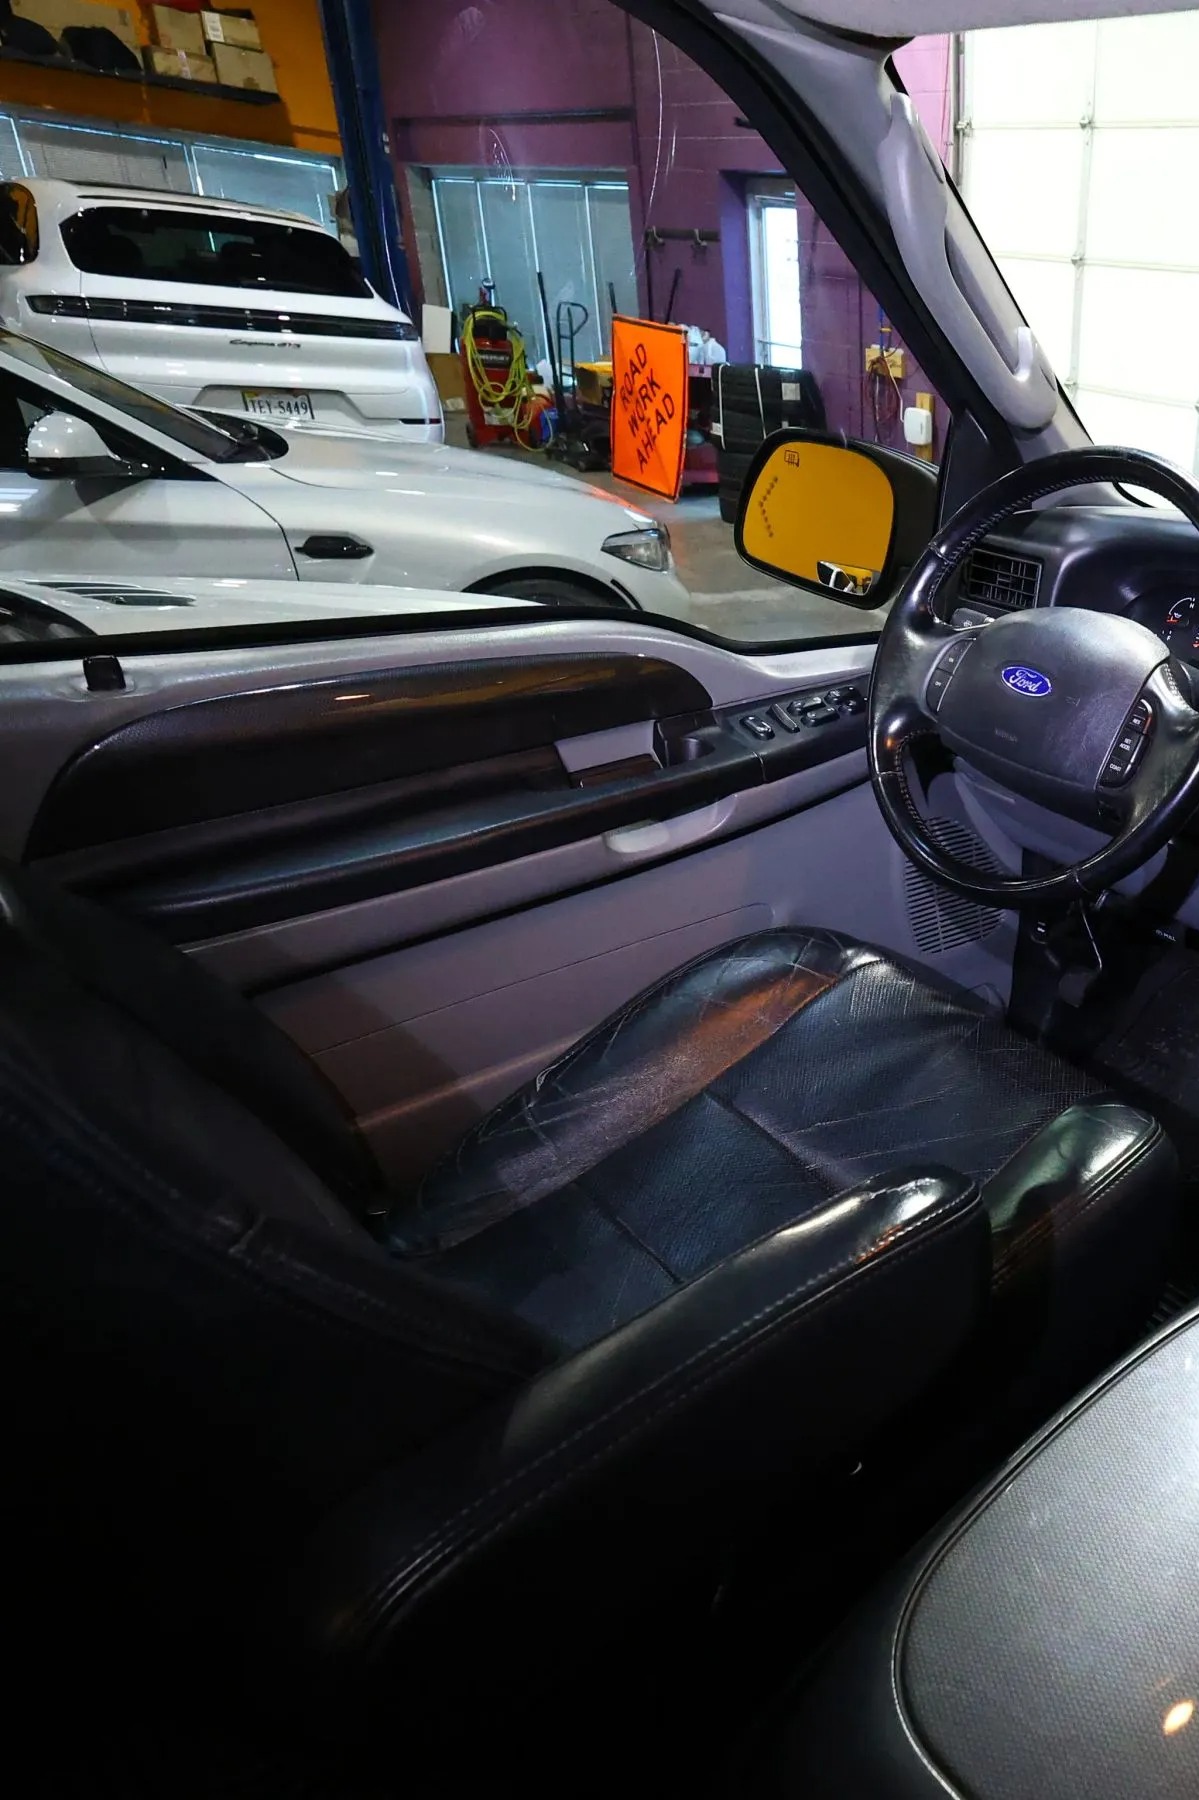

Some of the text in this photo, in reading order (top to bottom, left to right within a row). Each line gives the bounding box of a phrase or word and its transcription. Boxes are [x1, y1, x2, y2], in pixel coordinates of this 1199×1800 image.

[619, 343, 648, 411] ROAD
[628, 367, 661, 438] WORK
[635, 392, 675, 475] AHEAD
[1009, 669, 1042, 693] Ford
